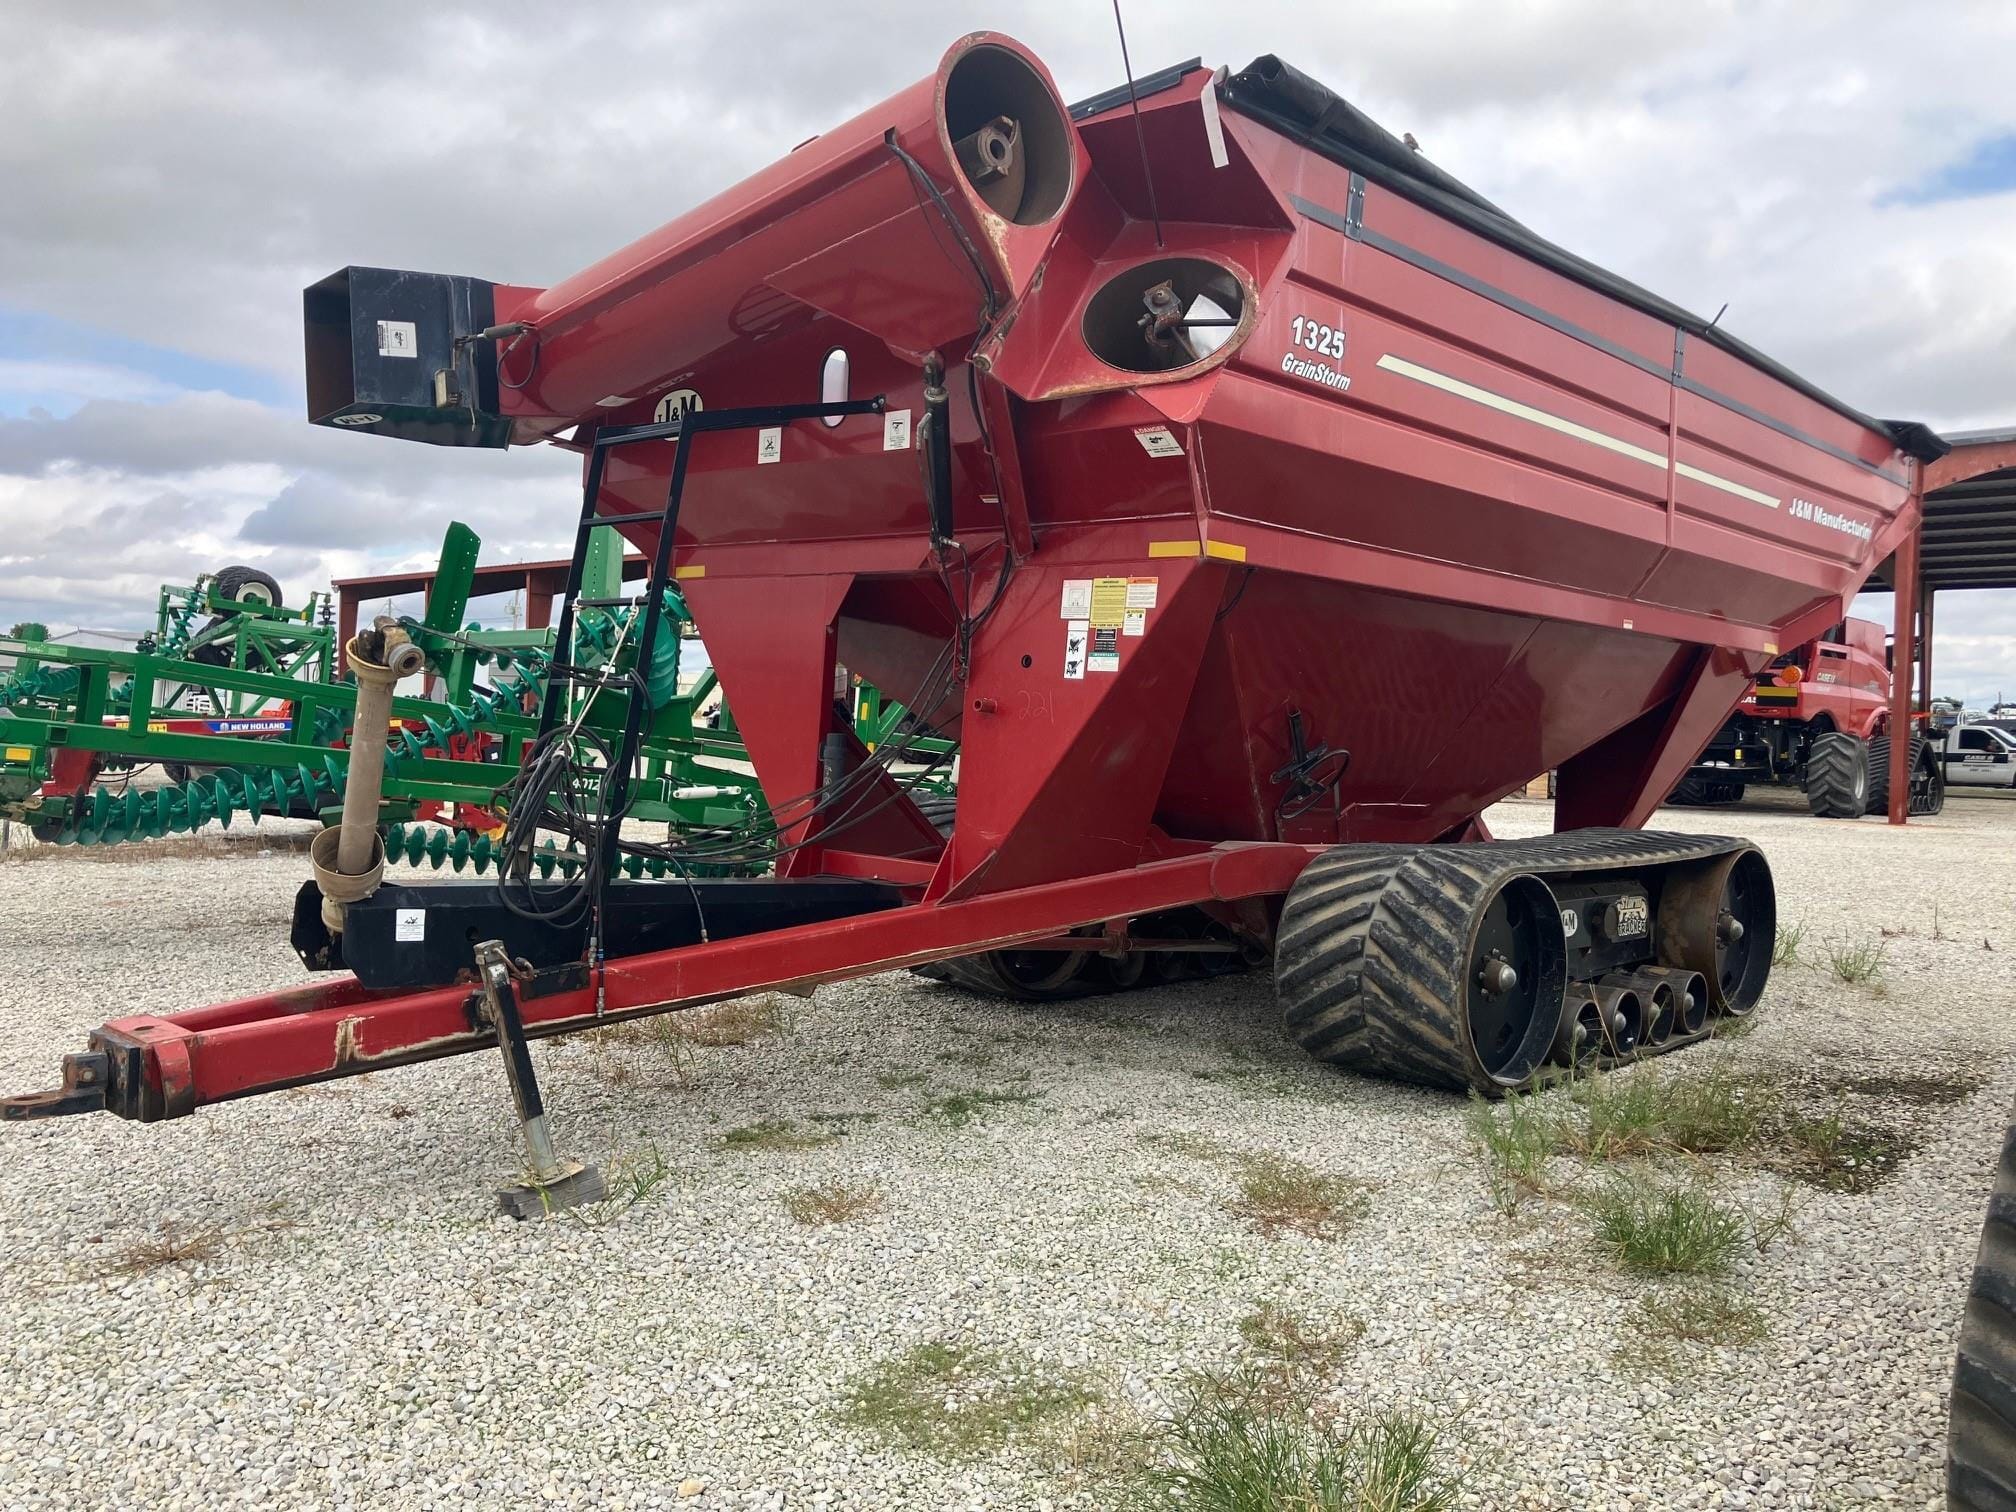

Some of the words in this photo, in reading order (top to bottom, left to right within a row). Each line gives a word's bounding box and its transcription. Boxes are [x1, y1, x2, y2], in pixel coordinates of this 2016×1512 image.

[1292, 315, 1346, 360] 1325
[1281, 352, 1351, 391] GrainStorm
[1789, 498, 1813, 520] J&M
[231, 723, 249, 731] NEW
[250, 722, 286, 730] HOLLAND
